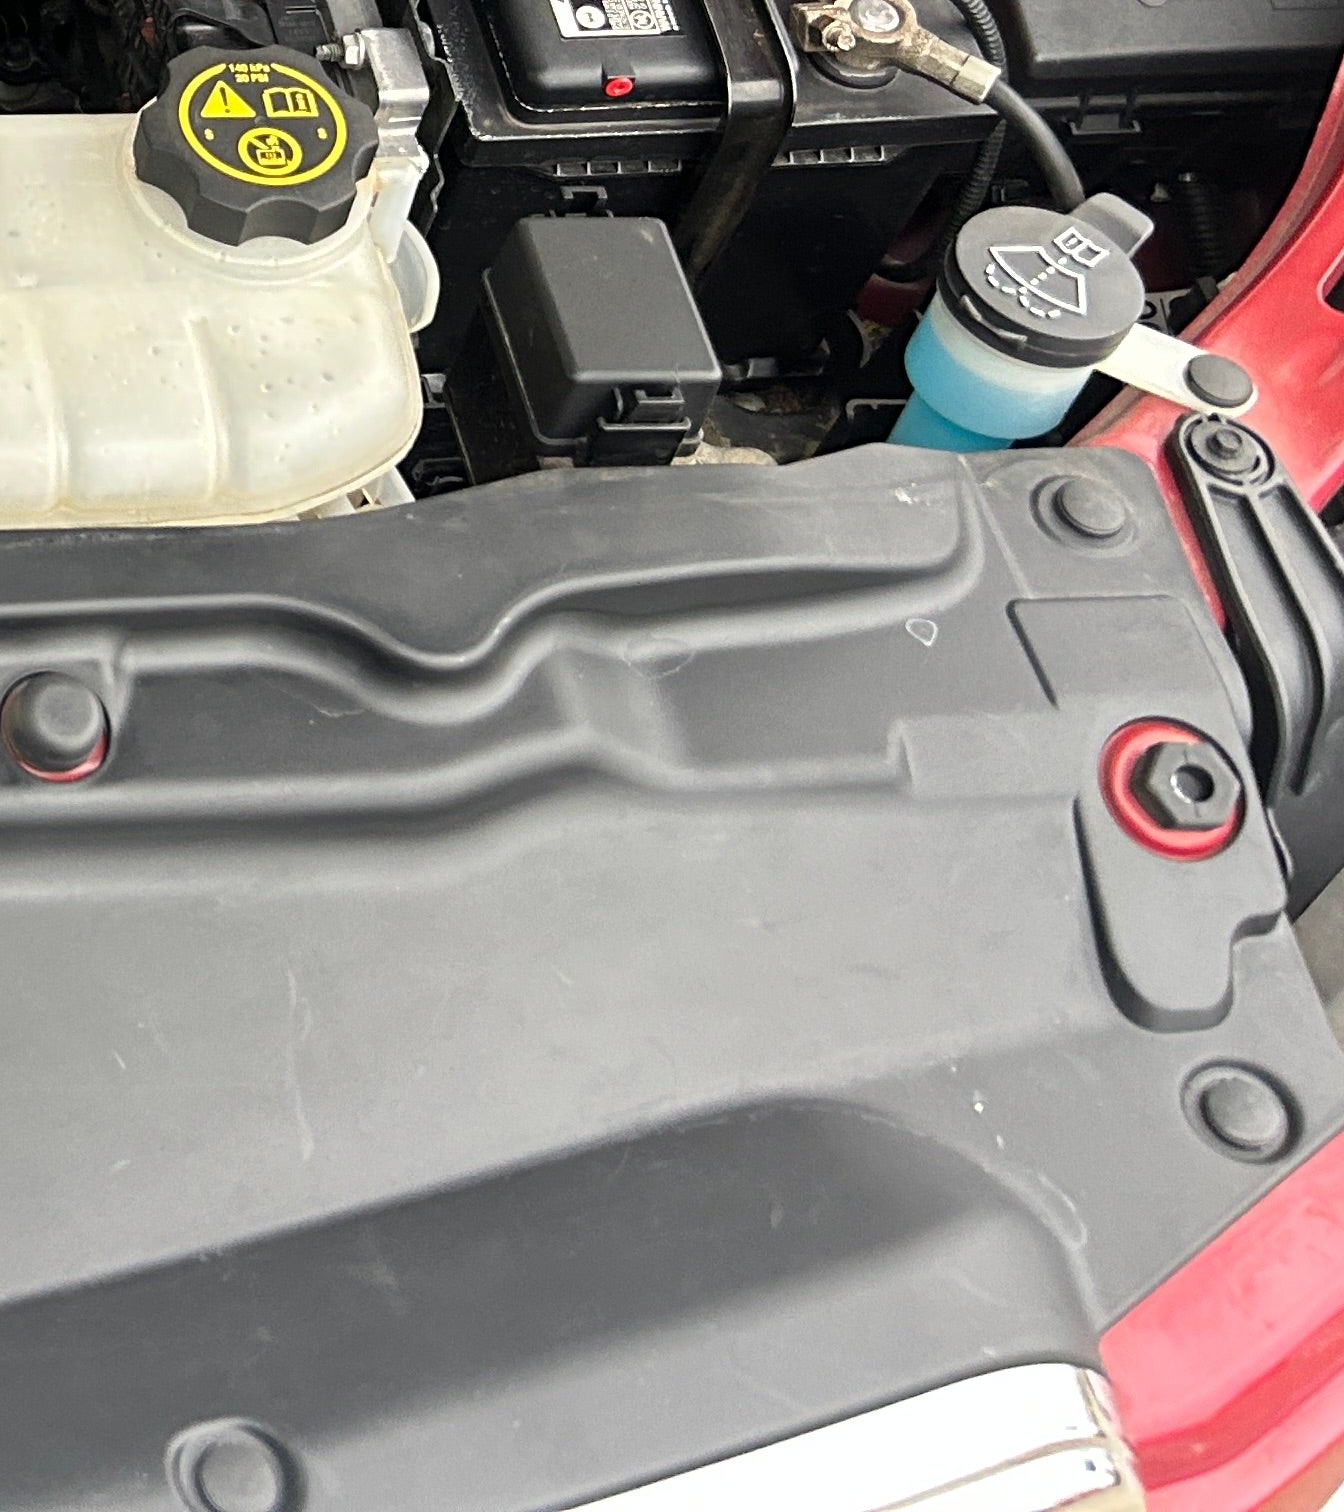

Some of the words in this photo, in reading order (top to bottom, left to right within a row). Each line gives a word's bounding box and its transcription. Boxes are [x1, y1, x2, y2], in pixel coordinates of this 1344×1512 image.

[228, 63, 249, 73] 140
[249, 63, 270, 73] kPa
[234, 73, 250, 83] 20
[250, 73, 269, 83] PSI
